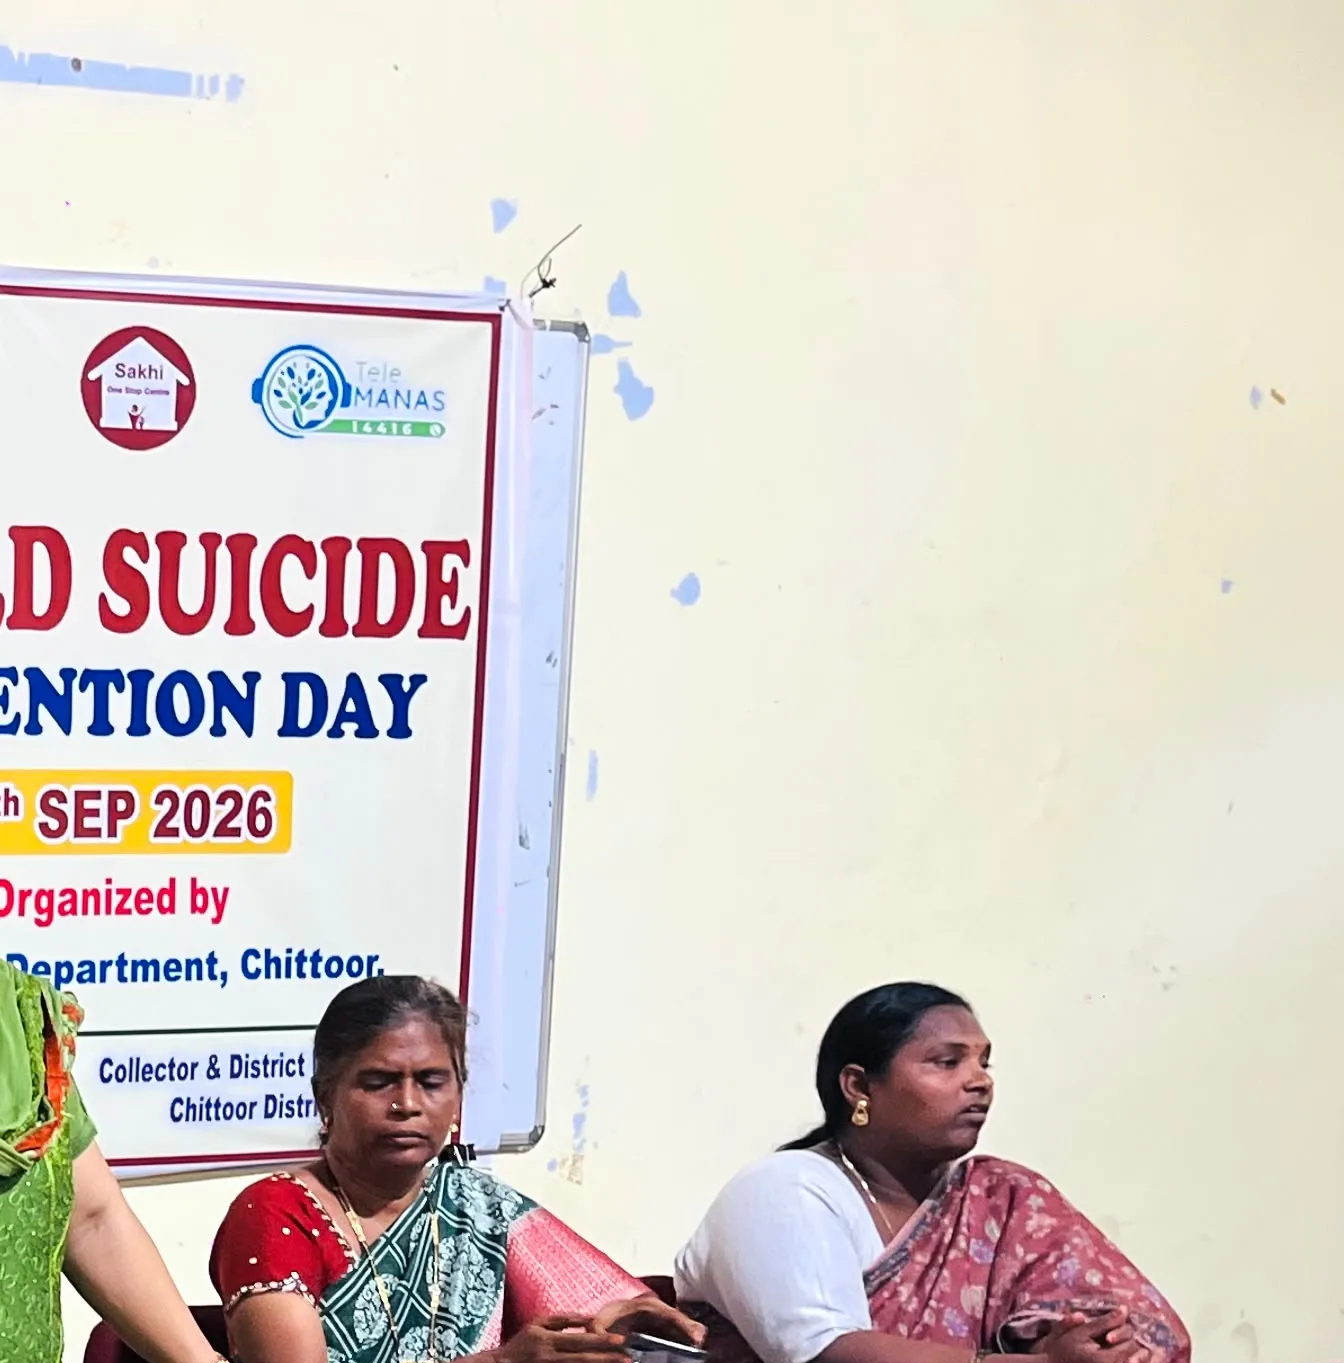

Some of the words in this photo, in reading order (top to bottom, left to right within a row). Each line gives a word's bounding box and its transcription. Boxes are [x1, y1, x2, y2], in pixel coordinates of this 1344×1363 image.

[114, 362, 164, 380] Sakhi
[354, 361, 402, 383] Tele
[354, 387, 446, 412] MANAS
[352, 420, 413, 435] 14416
[98, 528, 471, 640] SUICIDE
[277, 672, 428, 739] DAY
[38, 789, 136, 839] SEP
[153, 789, 274, 840] 2026
[190, 877, 229, 925] by
[100, 1057, 199, 1084] Collector
[206, 1054, 220, 1080] &
[230, 1052, 305, 1079] District
[170, 1096, 257, 1123] Chittoor
